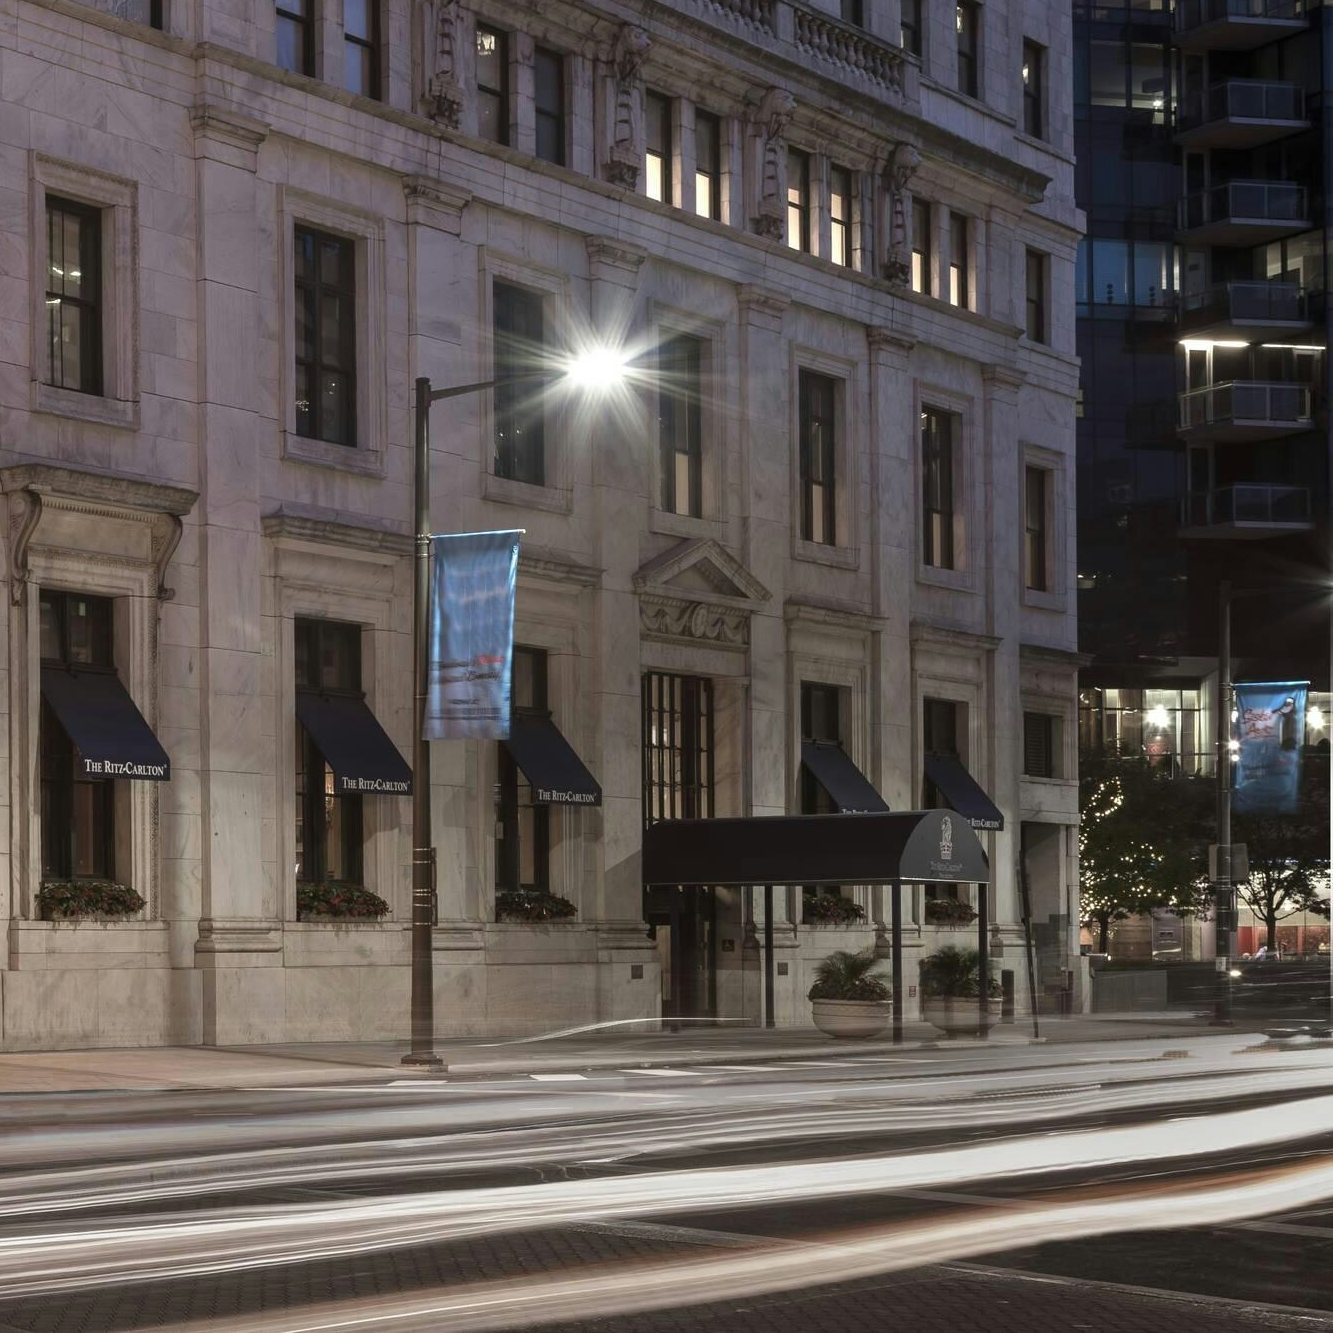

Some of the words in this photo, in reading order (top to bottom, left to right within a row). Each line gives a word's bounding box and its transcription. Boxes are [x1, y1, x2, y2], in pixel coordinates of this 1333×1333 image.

[85, 759, 102, 773] THE
[341, 777, 357, 789] THE
[537, 789, 551, 801] THE
